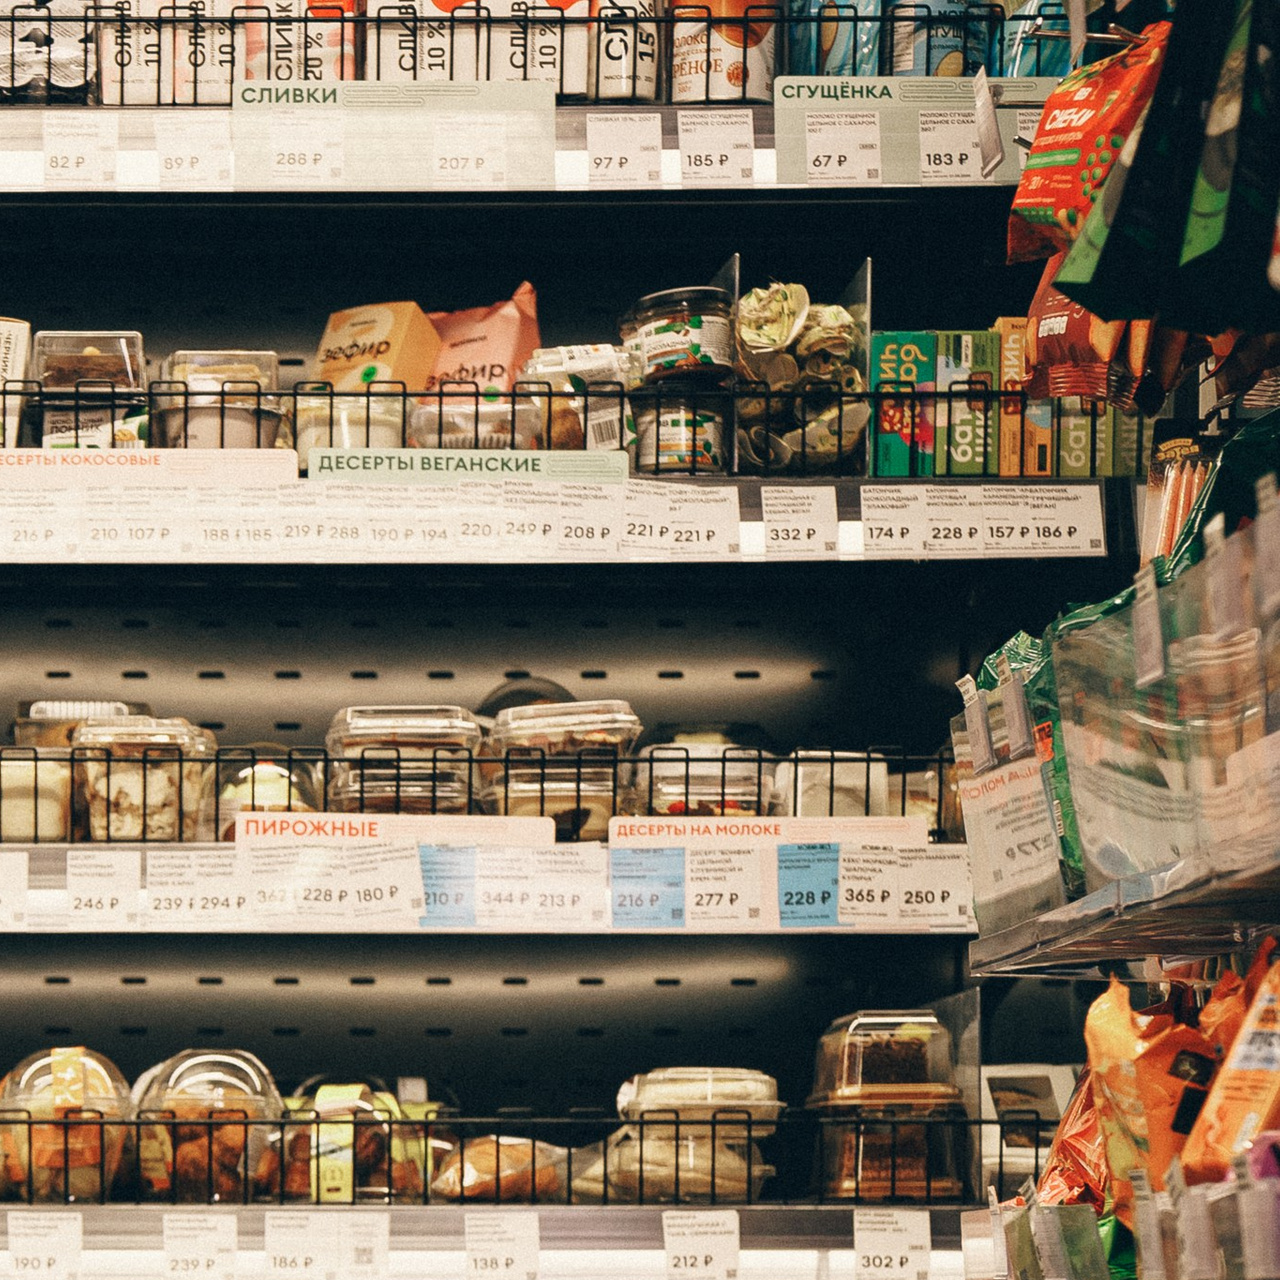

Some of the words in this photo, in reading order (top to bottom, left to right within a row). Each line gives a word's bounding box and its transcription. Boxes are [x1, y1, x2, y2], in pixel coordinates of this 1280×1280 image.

[639, 31, 655, 63] 15
[428, 47, 446, 70] 10
[539, 45, 557, 69] 10
[241, 87, 337, 104] СЛИВКИ
[781, 82, 894, 101] СГУЩЁНКА
[50, 156, 68, 168] 82
[276, 153, 307, 165] 288
[439, 157, 469, 169] 207
[593, 157, 612, 169] 97
[687, 154, 713, 166] 185
[812, 155, 831, 167] 67
[926, 153, 953, 166] 183
[61, 454, 160, 467] КОКОСОВЫЕ
[319, 455, 414, 473] ДЕСЕРТЫ
[421, 456, 542, 473] ВЕГАНСКИЕ
[285, 525, 310, 537] 219
[506, 523, 536, 535] 249
[564, 526, 594, 539] 208
[627, 523, 653, 536] 221
[770, 528, 800, 540] 332
[868, 527, 893, 539] 174
[932, 527, 962, 539] 228
[988, 526, 1014, 539] 157
[1036, 526, 1061, 538] 186
[674, 530, 700, 542] 221
[245, 819, 379, 837] ПИРОЖНЫЕ
[617, 823, 687, 837] ДЕСЕРТЫ
[691, 824, 712, 837] НА
[716, 824, 782, 837] МОЛОКЕ
[303, 888, 333, 901] 228
[356, 888, 382, 901] 180
[482, 892, 514, 904] 344
[539, 893, 564, 905] 213
[617, 894, 644, 906] 216
[694, 893, 723, 906] 277
[784, 892, 815, 905] 228
[844, 890, 875, 902] 365
[903, 891, 934, 904] 250
[73, 898, 102, 910] 246
[153, 898, 182, 910] 239
[200, 897, 229, 910] 294
[473, 1257, 498, 1269] 138
[672, 1256, 698, 1267] 212
[861, 1255, 892, 1267] 302
